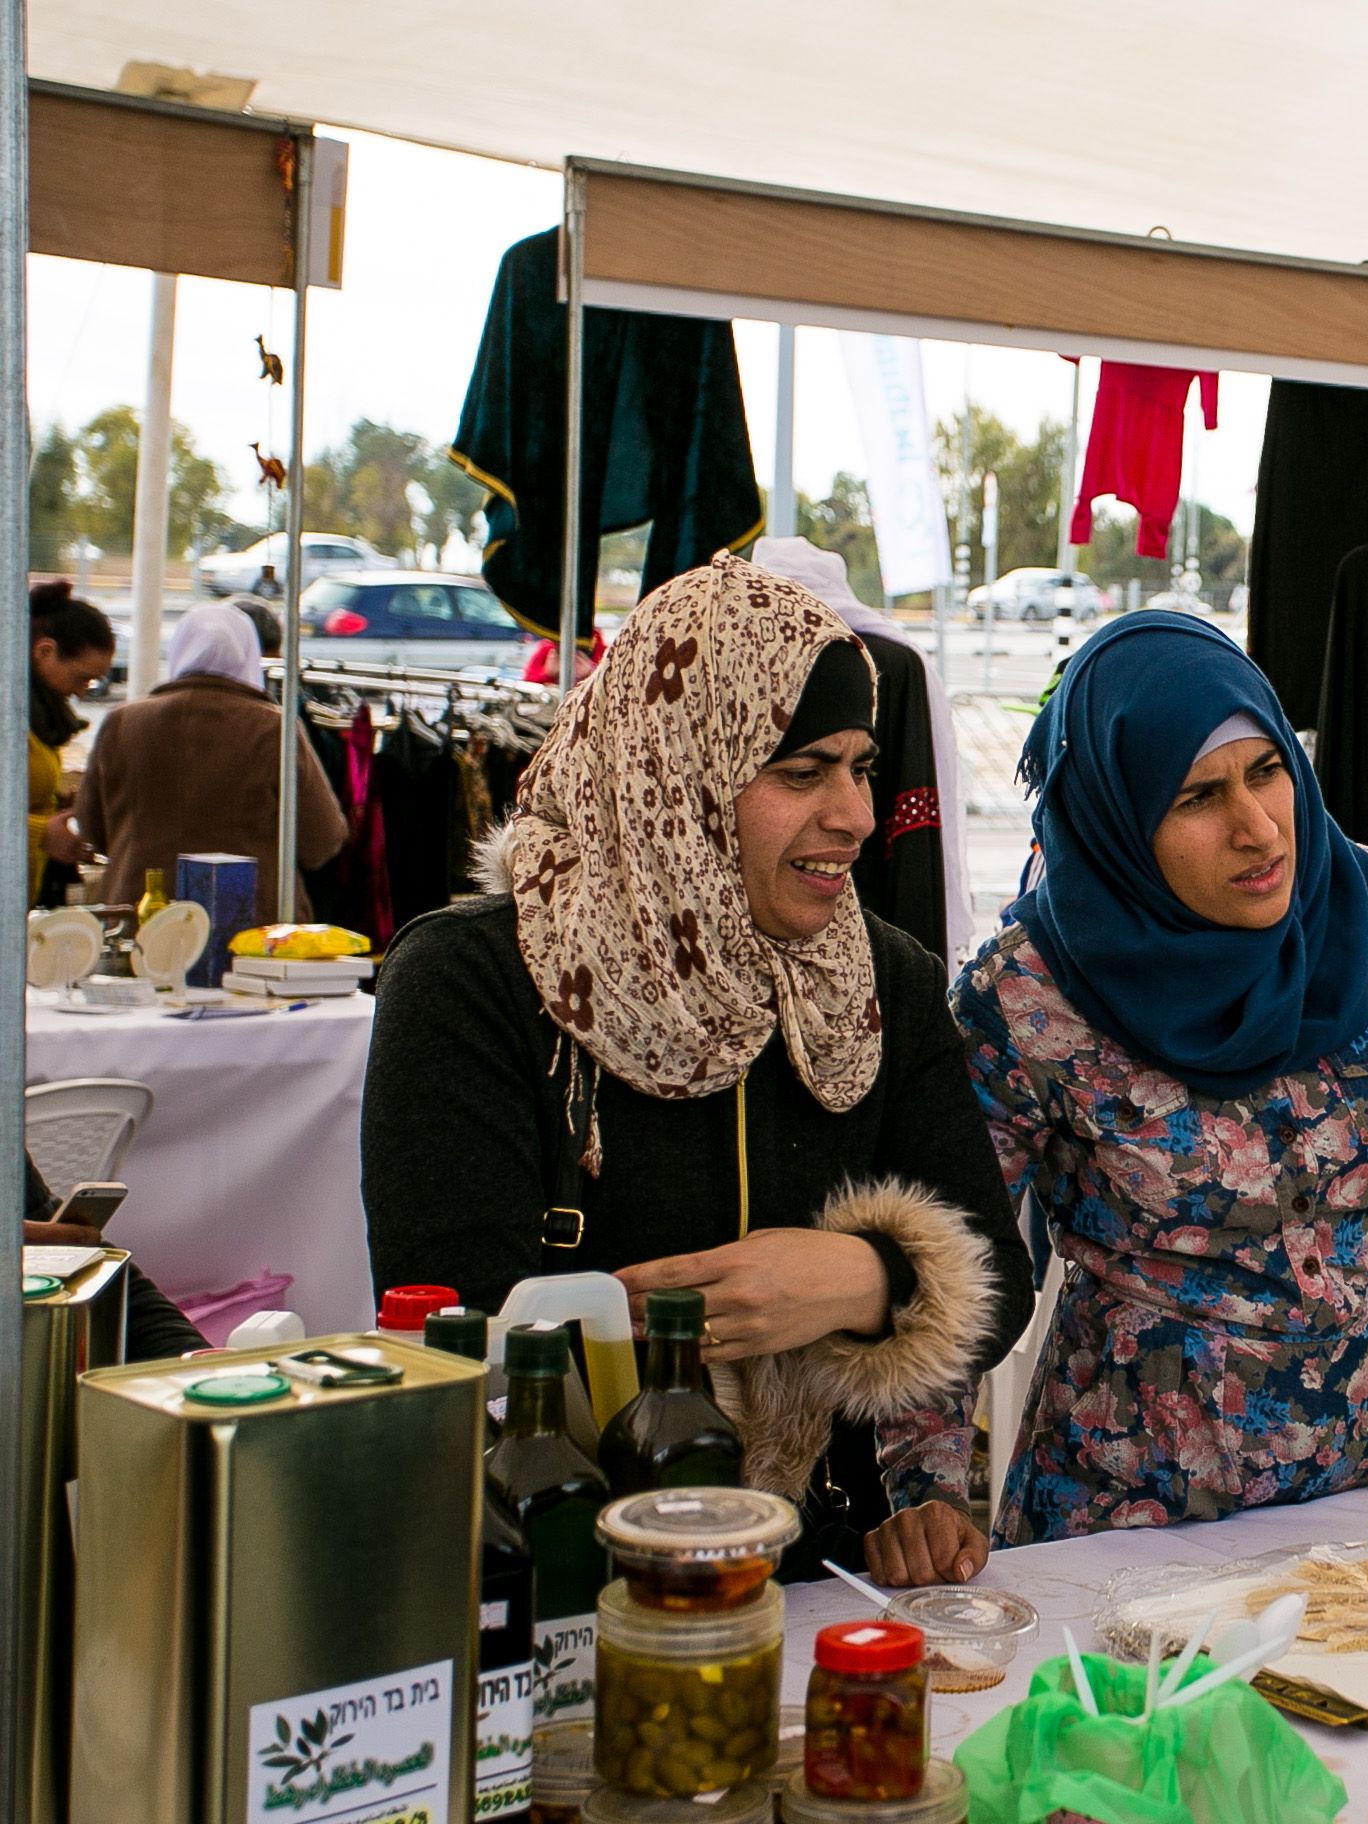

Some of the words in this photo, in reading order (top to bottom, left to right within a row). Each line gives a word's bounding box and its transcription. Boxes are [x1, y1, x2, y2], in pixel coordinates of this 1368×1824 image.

[553, 1626, 594, 1659] הירוק
[384, 1687, 405, 1714] בד
[411, 1678, 440, 1707] בית
[478, 1676, 511, 1708] הירו
[328, 1694, 377, 1735] הירוק
